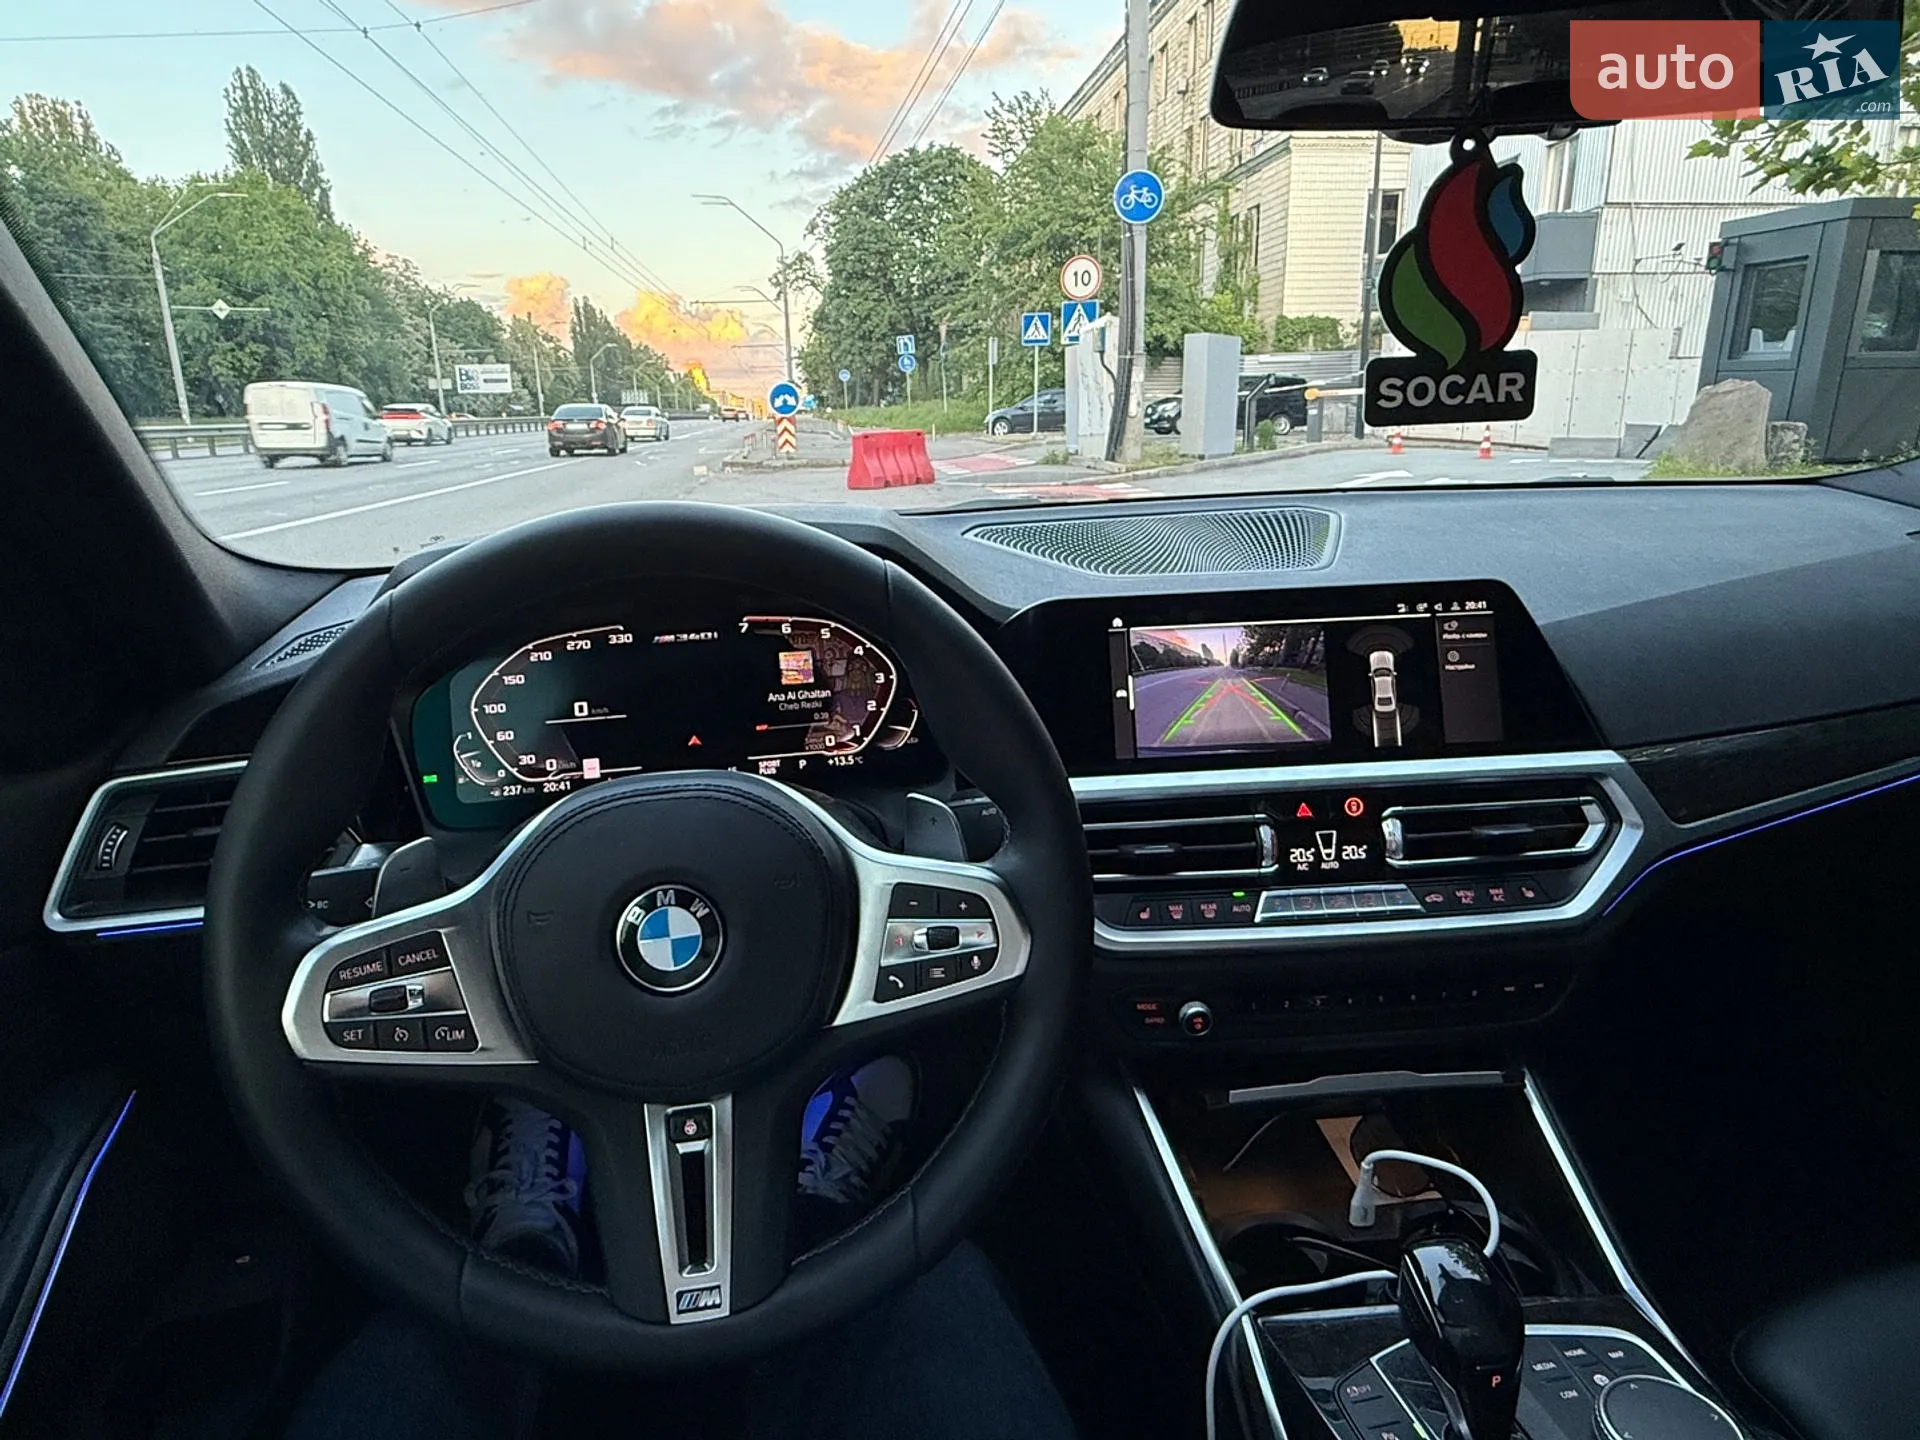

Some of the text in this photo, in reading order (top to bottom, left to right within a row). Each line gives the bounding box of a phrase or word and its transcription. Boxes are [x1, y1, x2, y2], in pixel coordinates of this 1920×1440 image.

[1073, 270, 1091, 287] 10
[1376, 371, 1526, 409] SOCAR
[1465, 601, 1487, 610] 20:41
[738, 622, 749, 633] 7
[781, 623, 792, 634] 6
[608, 633, 633, 644] 330
[820, 628, 831, 639] 5
[566, 640, 591, 651] 270
[853, 645, 864, 656] 4
[529, 651, 552, 662] 210
[502, 674, 525, 685] 150
[875, 672, 885, 683] 3
[768, 692, 785, 702] Ana
[482, 703, 506, 714] 100
[573, 701, 589, 717] 0
[867, 700, 877, 711] 2
[466, 732, 472, 740] 1
[496, 730, 514, 741] 60
[852, 725, 860, 736] 1
[825, 735, 836, 746] 0
[518, 754, 536, 765] 30
[545, 759, 557, 771] 0
[758, 759, 781, 768] SPORT
[799, 759, 807, 769] P
[827, 756, 854, 766] +13.5
[498, 769, 506, 777] 0
[502, 785, 522, 796] 237
[542, 781, 571, 792] 20:41
[1320, 861, 1340, 869] AUTO
[626, 889, 710, 926] BMW
[1232, 904, 1251, 912] AUTO
[398, 948, 438, 966] CANCEL
[340, 961, 383, 981] RESUME
[343, 1029, 364, 1041] SET
[446, 1029, 465, 1040] LIM
[1532, 1361, 1557, 1371] MEDIA
[1492, 1375, 1501, 1388] P
